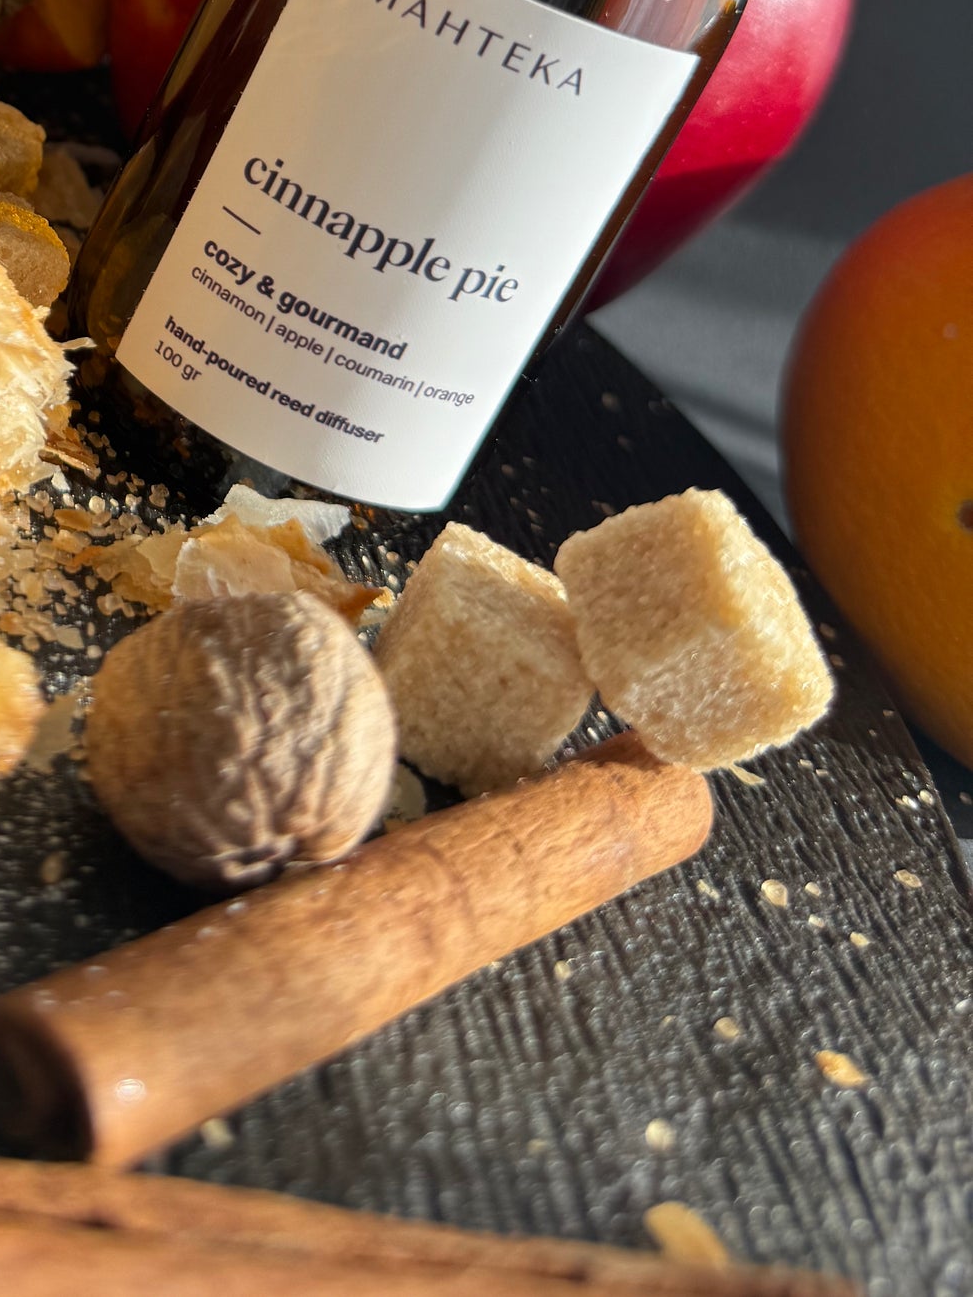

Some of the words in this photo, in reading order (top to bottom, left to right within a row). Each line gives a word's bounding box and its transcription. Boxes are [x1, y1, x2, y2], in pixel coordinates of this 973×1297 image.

[243, 157, 451, 283] cinnapple
[448, 264, 519, 302] pie
[154, 339, 183, 368] 100
[181, 363, 203, 381] gr
[191, 266, 265, 325] cinnamon
[275, 323, 324, 356] apple
[334, 354, 415, 392] coumarin
[424, 386, 475, 407] orange
[204, 239, 257, 286] cozy
[256, 275, 276, 299] &
[275, 291, 409, 361] gourmand
[164, 315, 271, 396] hand-poured
[270, 389, 315, 418] reed
[315, 410, 385, 444] diffuser
